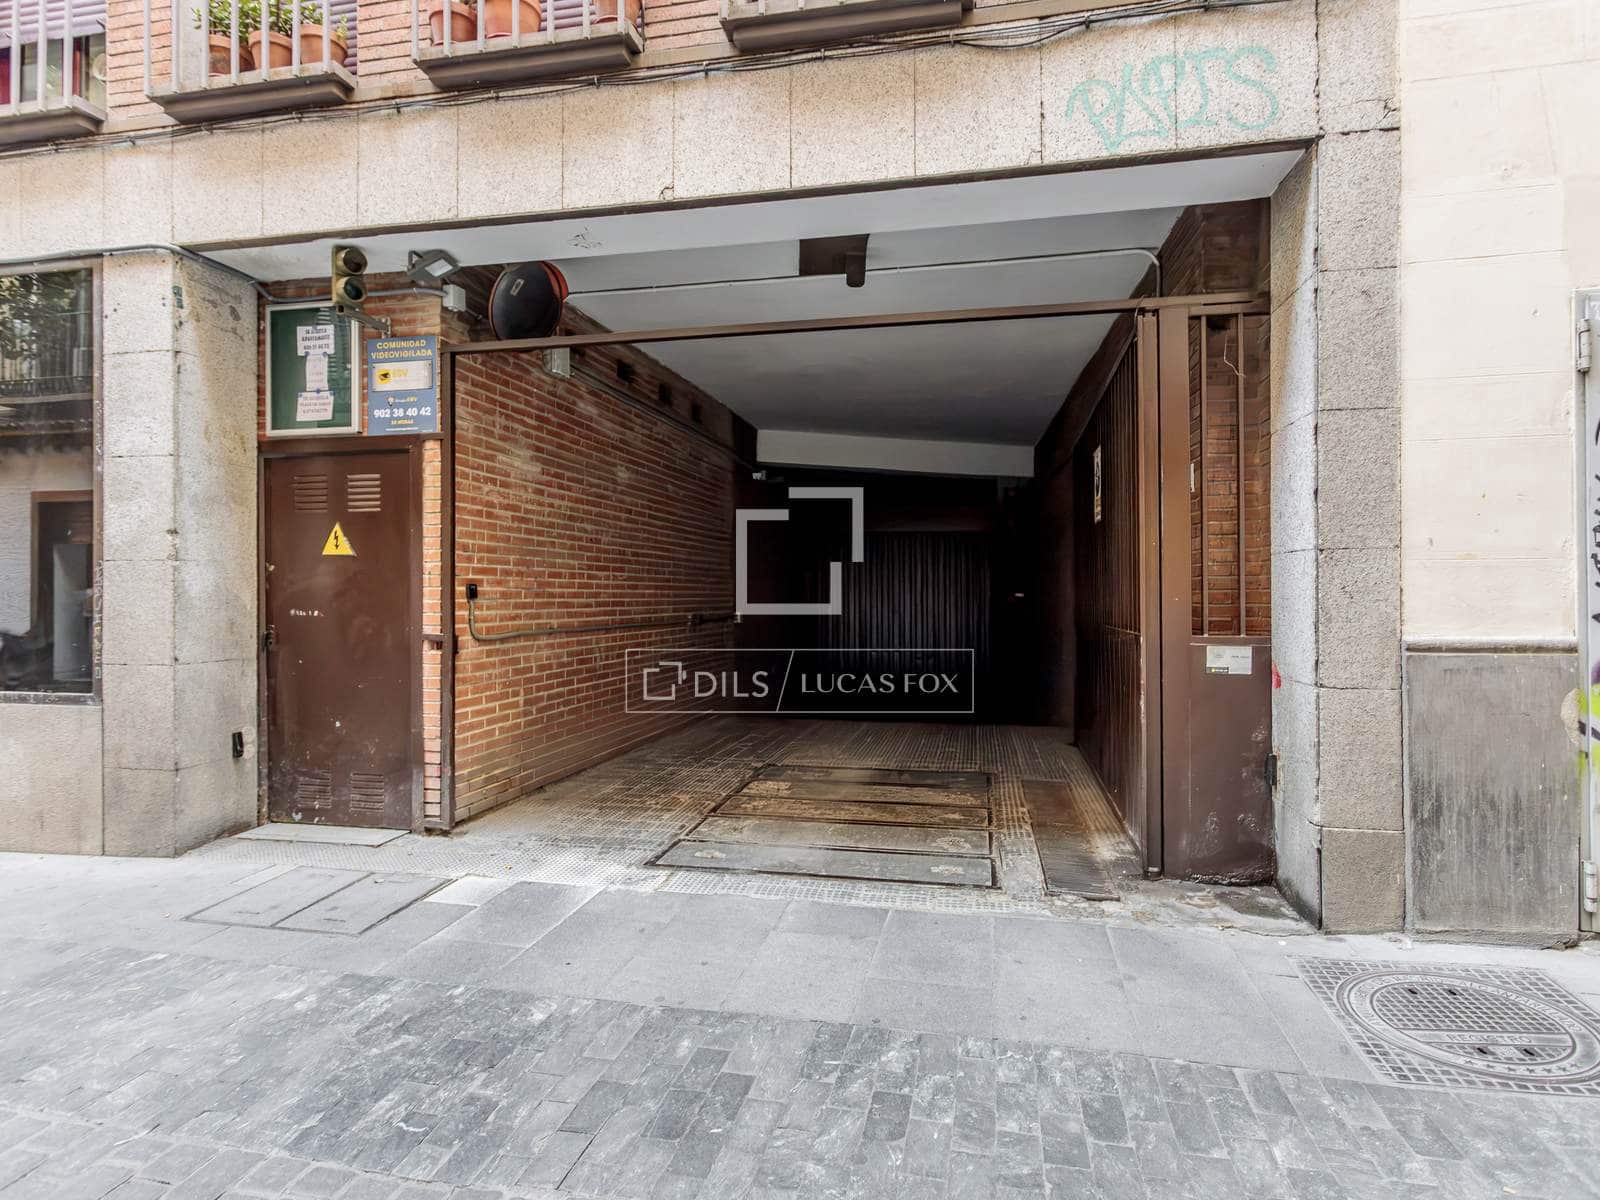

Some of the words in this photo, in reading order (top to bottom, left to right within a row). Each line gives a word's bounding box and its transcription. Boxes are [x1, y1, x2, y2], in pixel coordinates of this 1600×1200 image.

[377, 340, 426, 349] COMUNIDAD
[371, 350, 432, 359] VIDEOVIGILADA
[374, 409, 391, 418] 902
[392, 408, 404, 417] 38
[405, 407, 418, 416] 40
[419, 406, 432, 416] 42
[1449, 1032, 1532, 1043] REGISTRO
